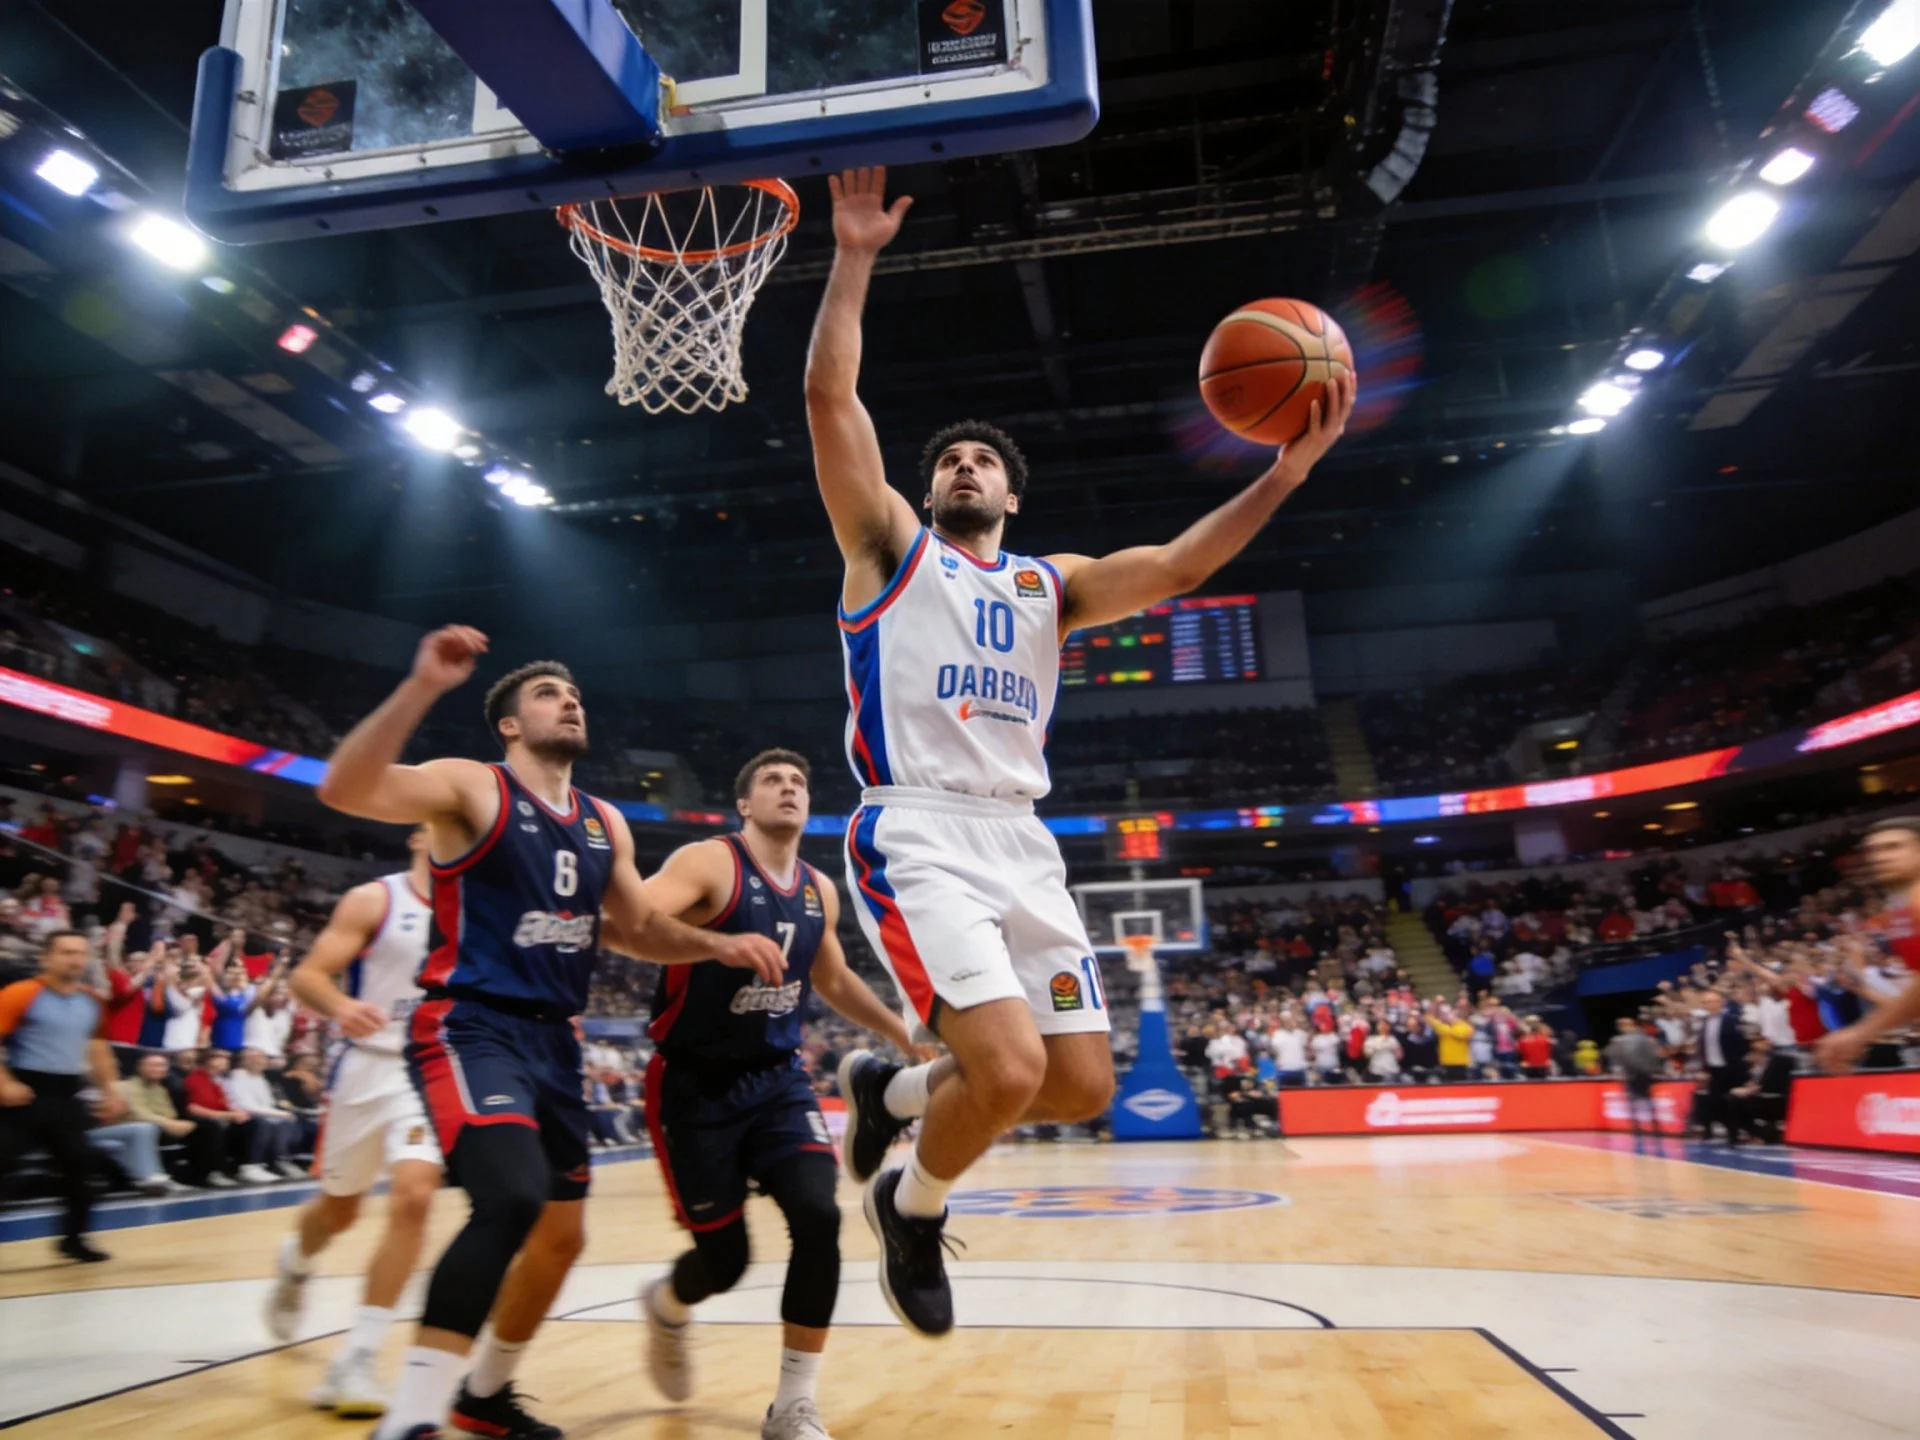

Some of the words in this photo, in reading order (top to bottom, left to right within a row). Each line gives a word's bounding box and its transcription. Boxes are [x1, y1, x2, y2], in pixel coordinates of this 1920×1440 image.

[974, 598, 1014, 653] 10
[554, 849, 578, 897] 6
[776, 921, 796, 960] 7
